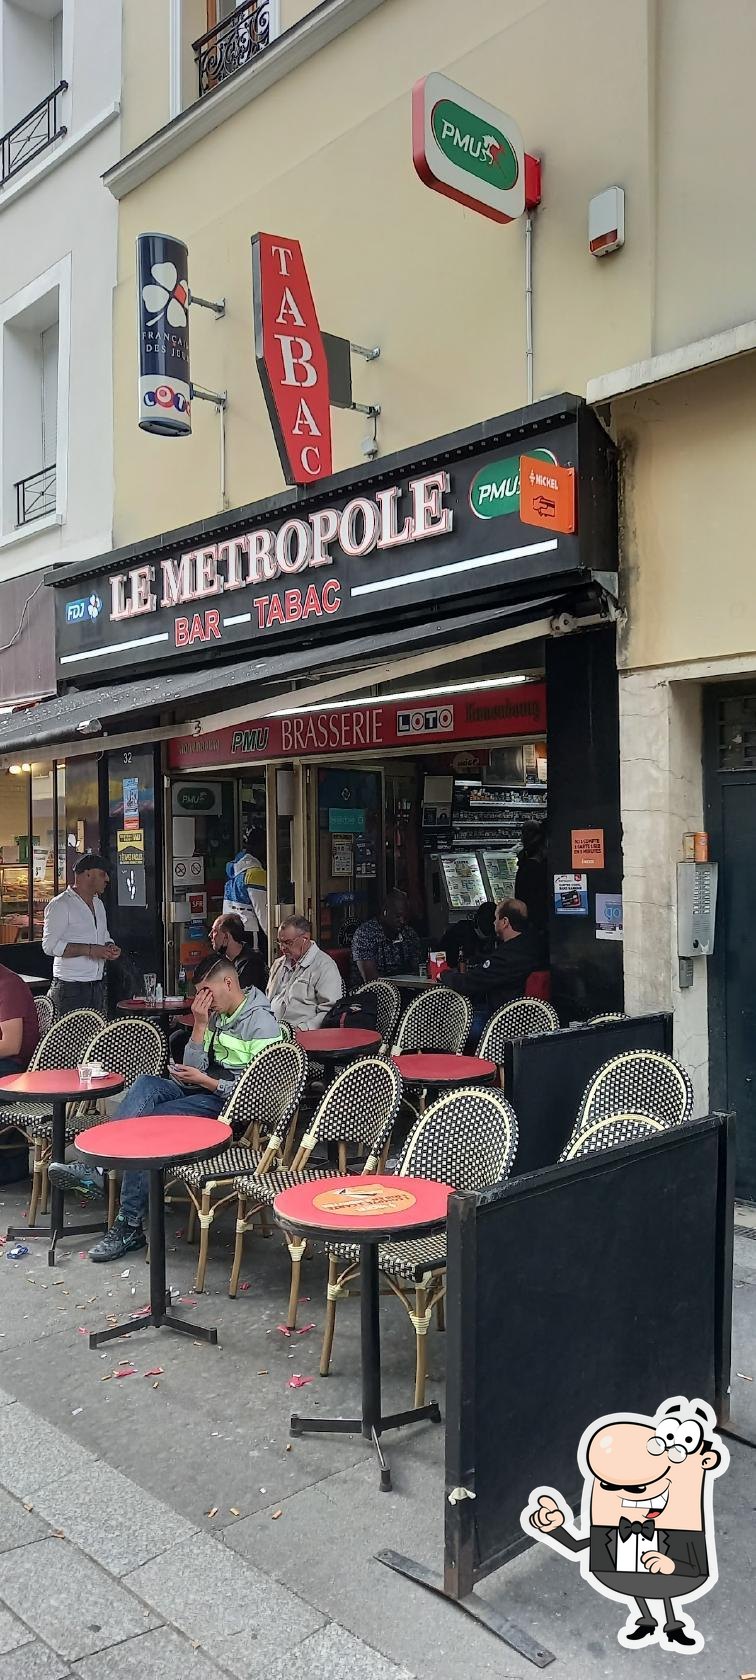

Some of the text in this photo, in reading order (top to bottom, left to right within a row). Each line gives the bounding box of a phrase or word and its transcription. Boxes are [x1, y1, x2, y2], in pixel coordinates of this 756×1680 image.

[441, 119, 482, 158] PMU
[146, 344, 166, 354] DES
[272, 246, 322, 475] TABAC
[478, 477, 520, 506] PMU
[109, 470, 453, 621] LE METROPOLE
[68, 602, 85, 621] FDJ
[174, 578, 341, 647] BAR TABAC
[281, 709, 383, 750] BRASSERIE
[398, 708, 453, 733] LOTO
[231, 727, 269, 753] PMU
[123, 752, 132, 764] 32
